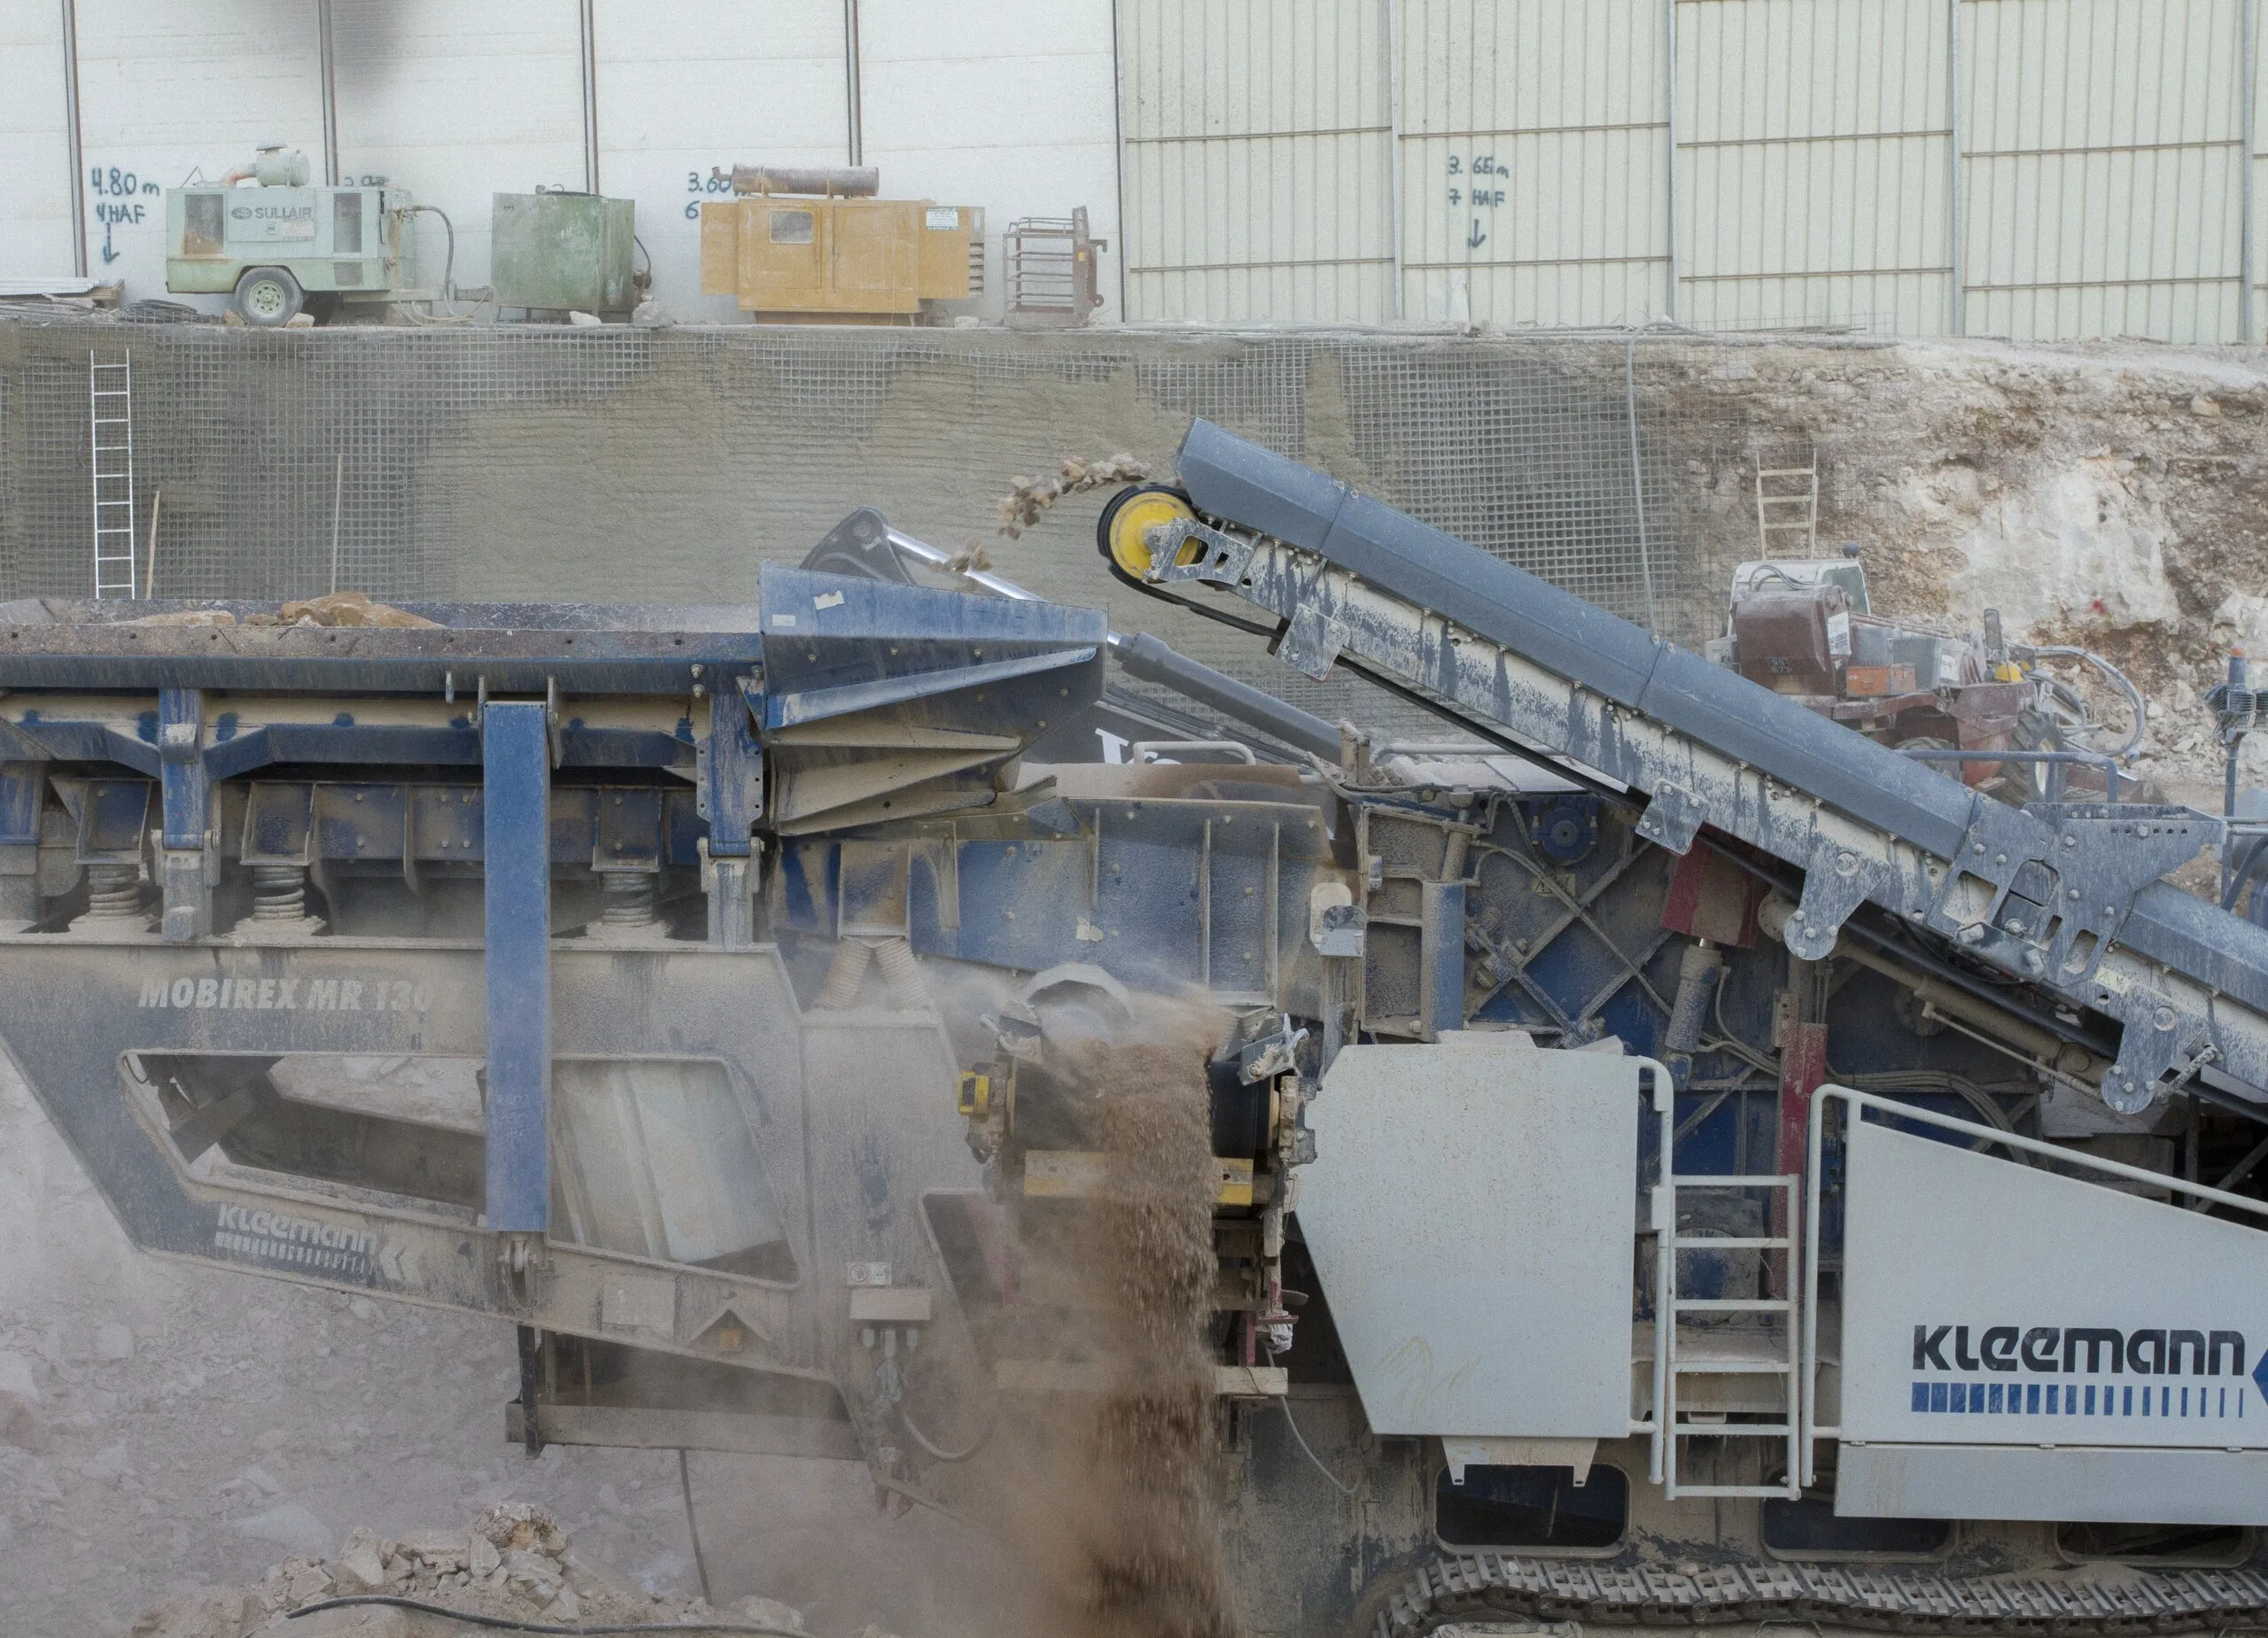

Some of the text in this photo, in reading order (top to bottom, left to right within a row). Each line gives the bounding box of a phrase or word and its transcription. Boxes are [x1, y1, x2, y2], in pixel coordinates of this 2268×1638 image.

[1472, 189, 1505, 207] HAF
[254, 206, 312, 220] SULLAIR
[138, 977, 299, 1010] MOBIREX
[307, 979, 364, 1012] MR
[376, 979, 435, 1013] 130
